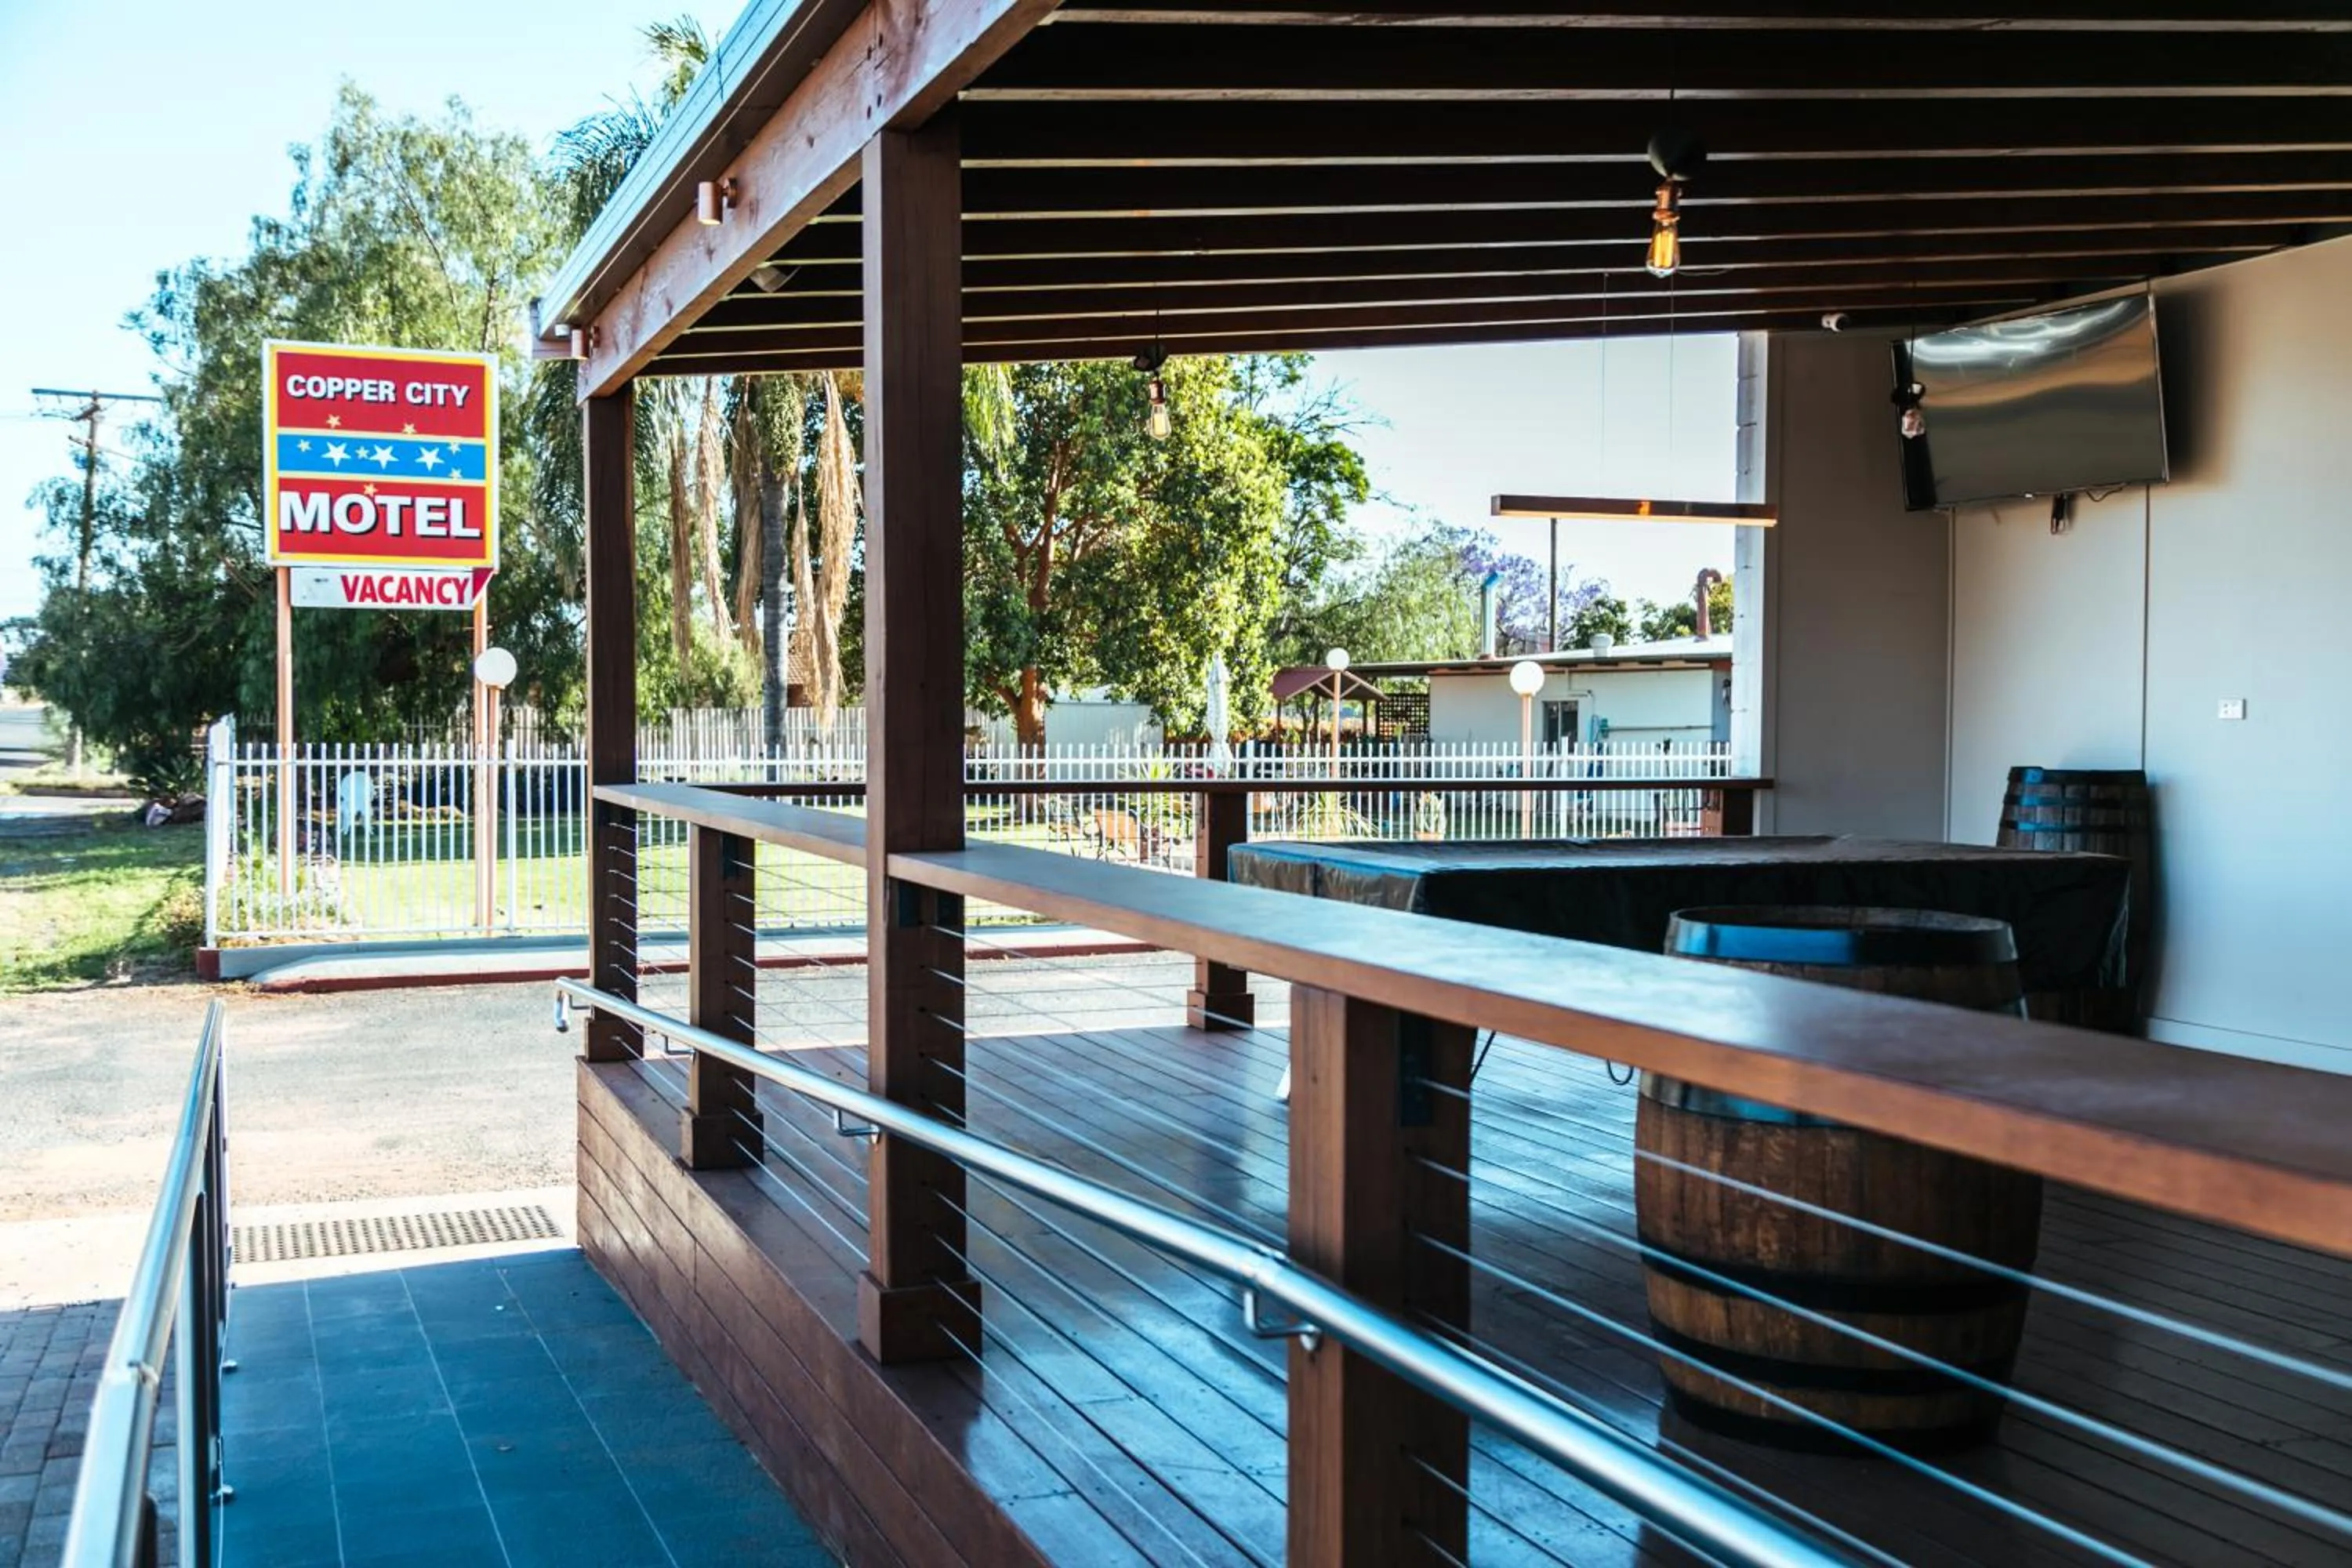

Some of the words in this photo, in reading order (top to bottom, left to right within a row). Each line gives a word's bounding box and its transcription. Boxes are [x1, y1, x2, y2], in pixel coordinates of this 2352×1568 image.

[286, 375, 396, 403] COPPER
[405, 382, 470, 407] CITY
[279, 491, 482, 539] MOTEL
[340, 575, 470, 604] VACANCY
